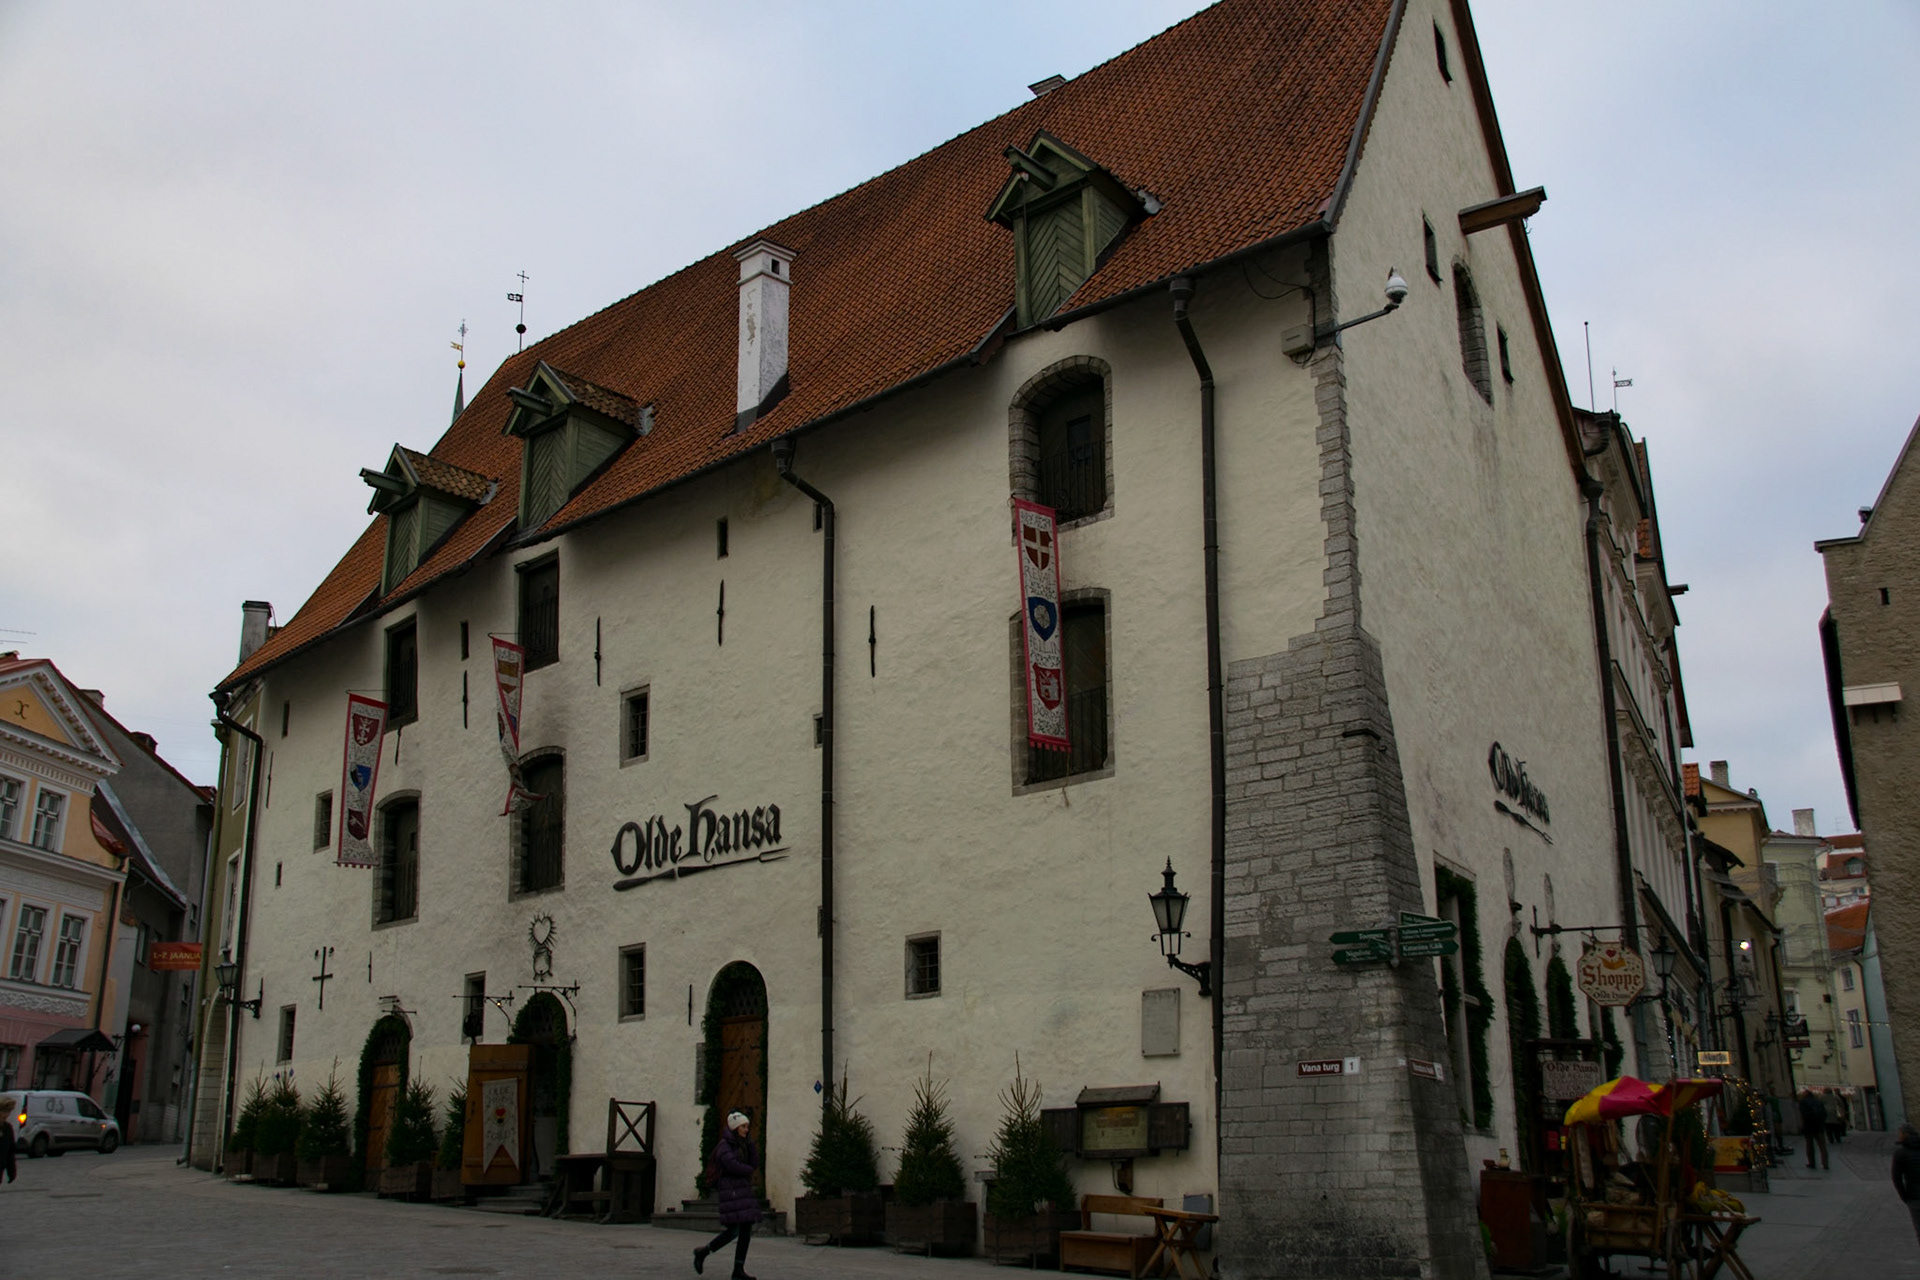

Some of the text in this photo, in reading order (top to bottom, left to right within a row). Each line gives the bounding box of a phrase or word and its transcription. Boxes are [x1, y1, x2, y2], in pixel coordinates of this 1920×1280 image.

[611, 814, 682, 875] Olde
[1581, 963, 1640, 990] Shoppe
[1301, 1062, 1340, 1073] Vana turg
[1547, 1062, 1569, 1072] Olde
